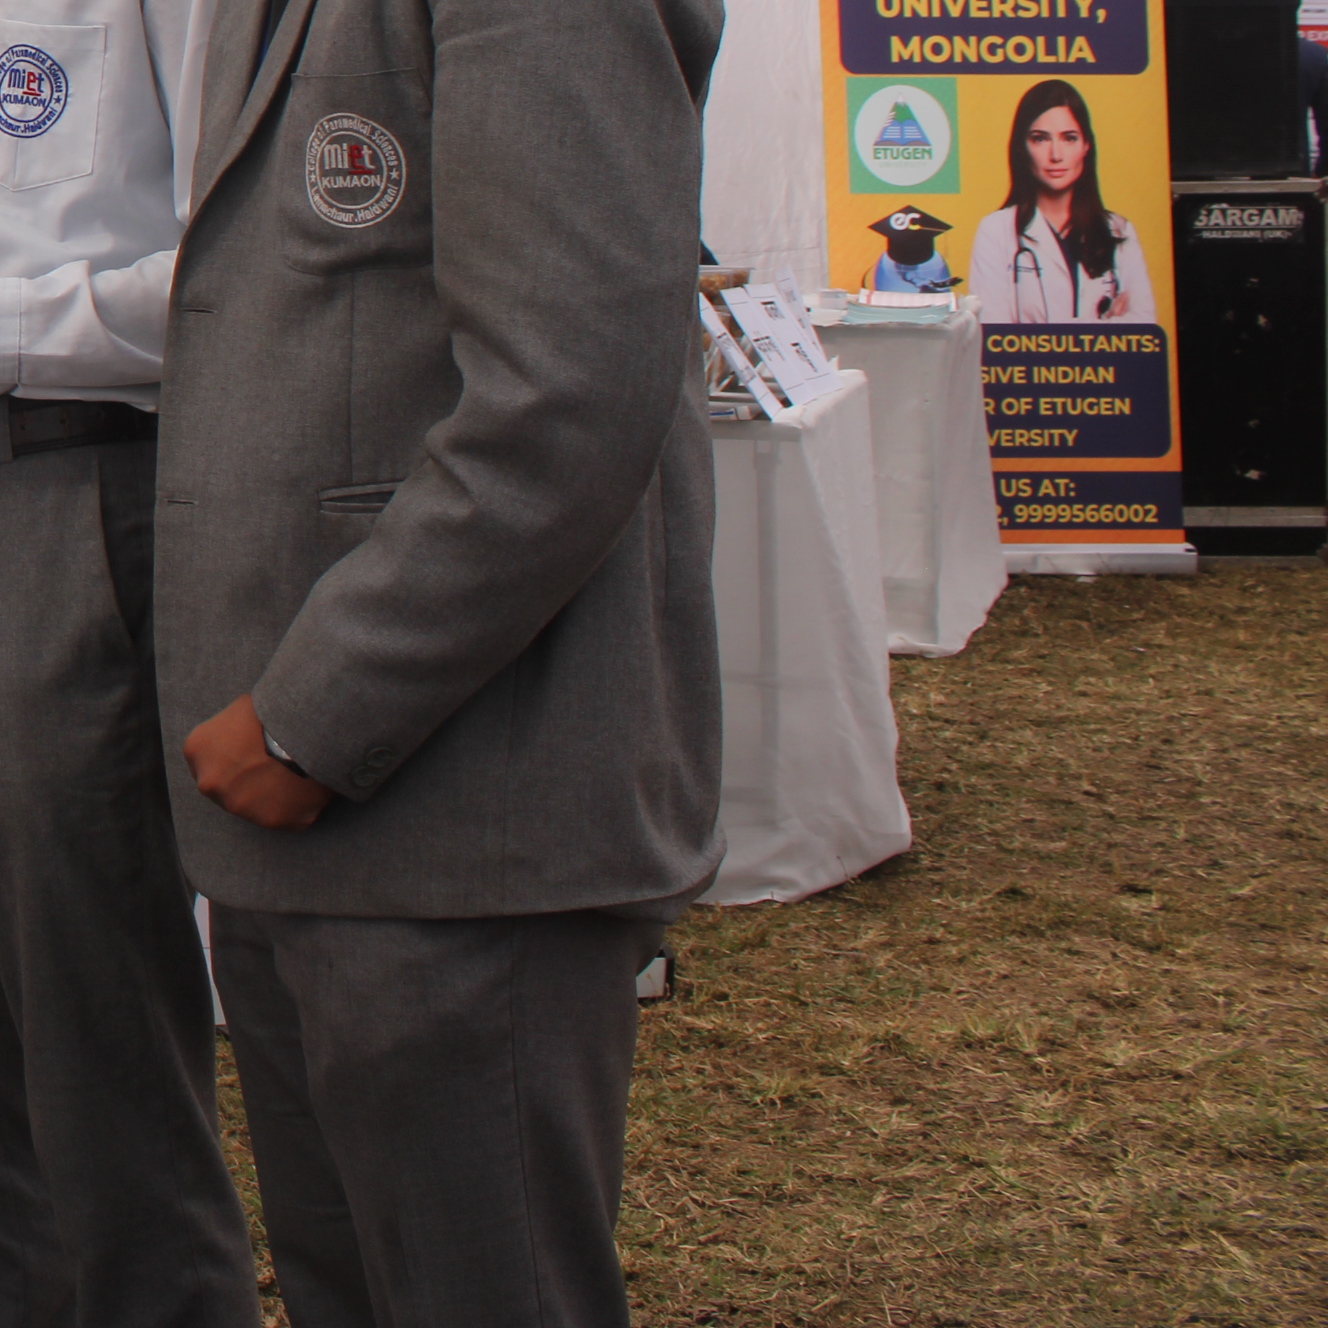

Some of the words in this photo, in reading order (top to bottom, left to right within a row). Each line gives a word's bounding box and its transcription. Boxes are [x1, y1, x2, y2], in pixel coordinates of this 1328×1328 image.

[889, 36, 1096, 63] MONGOLIA
[8, 68, 44, 93] miet
[2, 94, 46, 106] KUMAON
[323, 118, 372, 137] Paramedical
[324, 143, 376, 169] miet
[873, 147, 933, 160] ETUGEN
[323, 175, 381, 188] KUMAON
[987, 335, 1161, 353] CONSULTANTS:
[981, 366, 1027, 384] SIVE
[1033, 366, 1115, 384] INDIAN
[1001, 398, 1033, 415] OF
[1039, 398, 1131, 415] ETUGEN
[987, 429, 1078, 446] VERSITY
[1000, 479, 1032, 497] US
[1038, 479, 1076, 497] AT:
[1014, 504, 1158, 522] 9999566002
